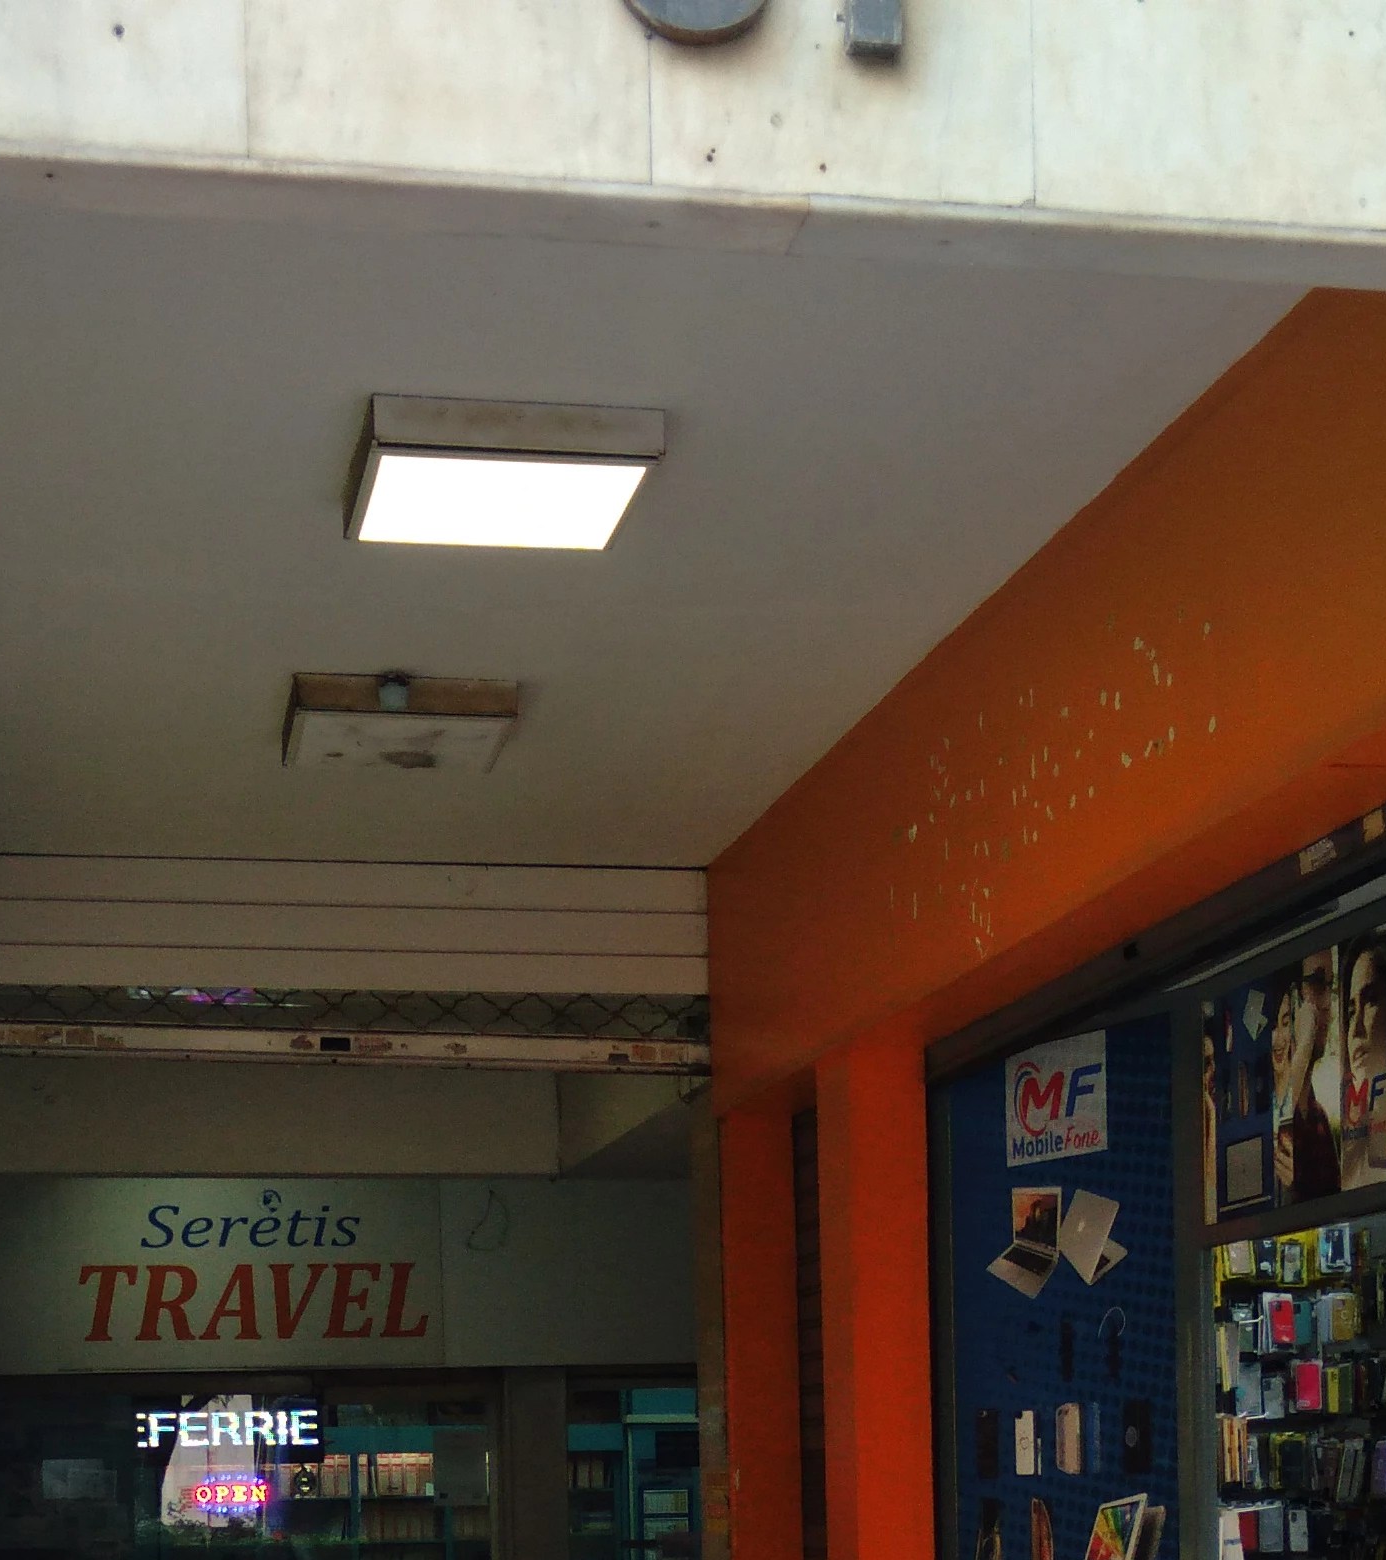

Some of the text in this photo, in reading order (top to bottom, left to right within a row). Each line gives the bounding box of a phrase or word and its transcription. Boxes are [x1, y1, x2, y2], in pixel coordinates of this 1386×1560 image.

[1015, 1062, 1103, 1136] MF
[78, 1263, 429, 1342] TRAVEL
[195, 1484, 268, 1502] OPEN
